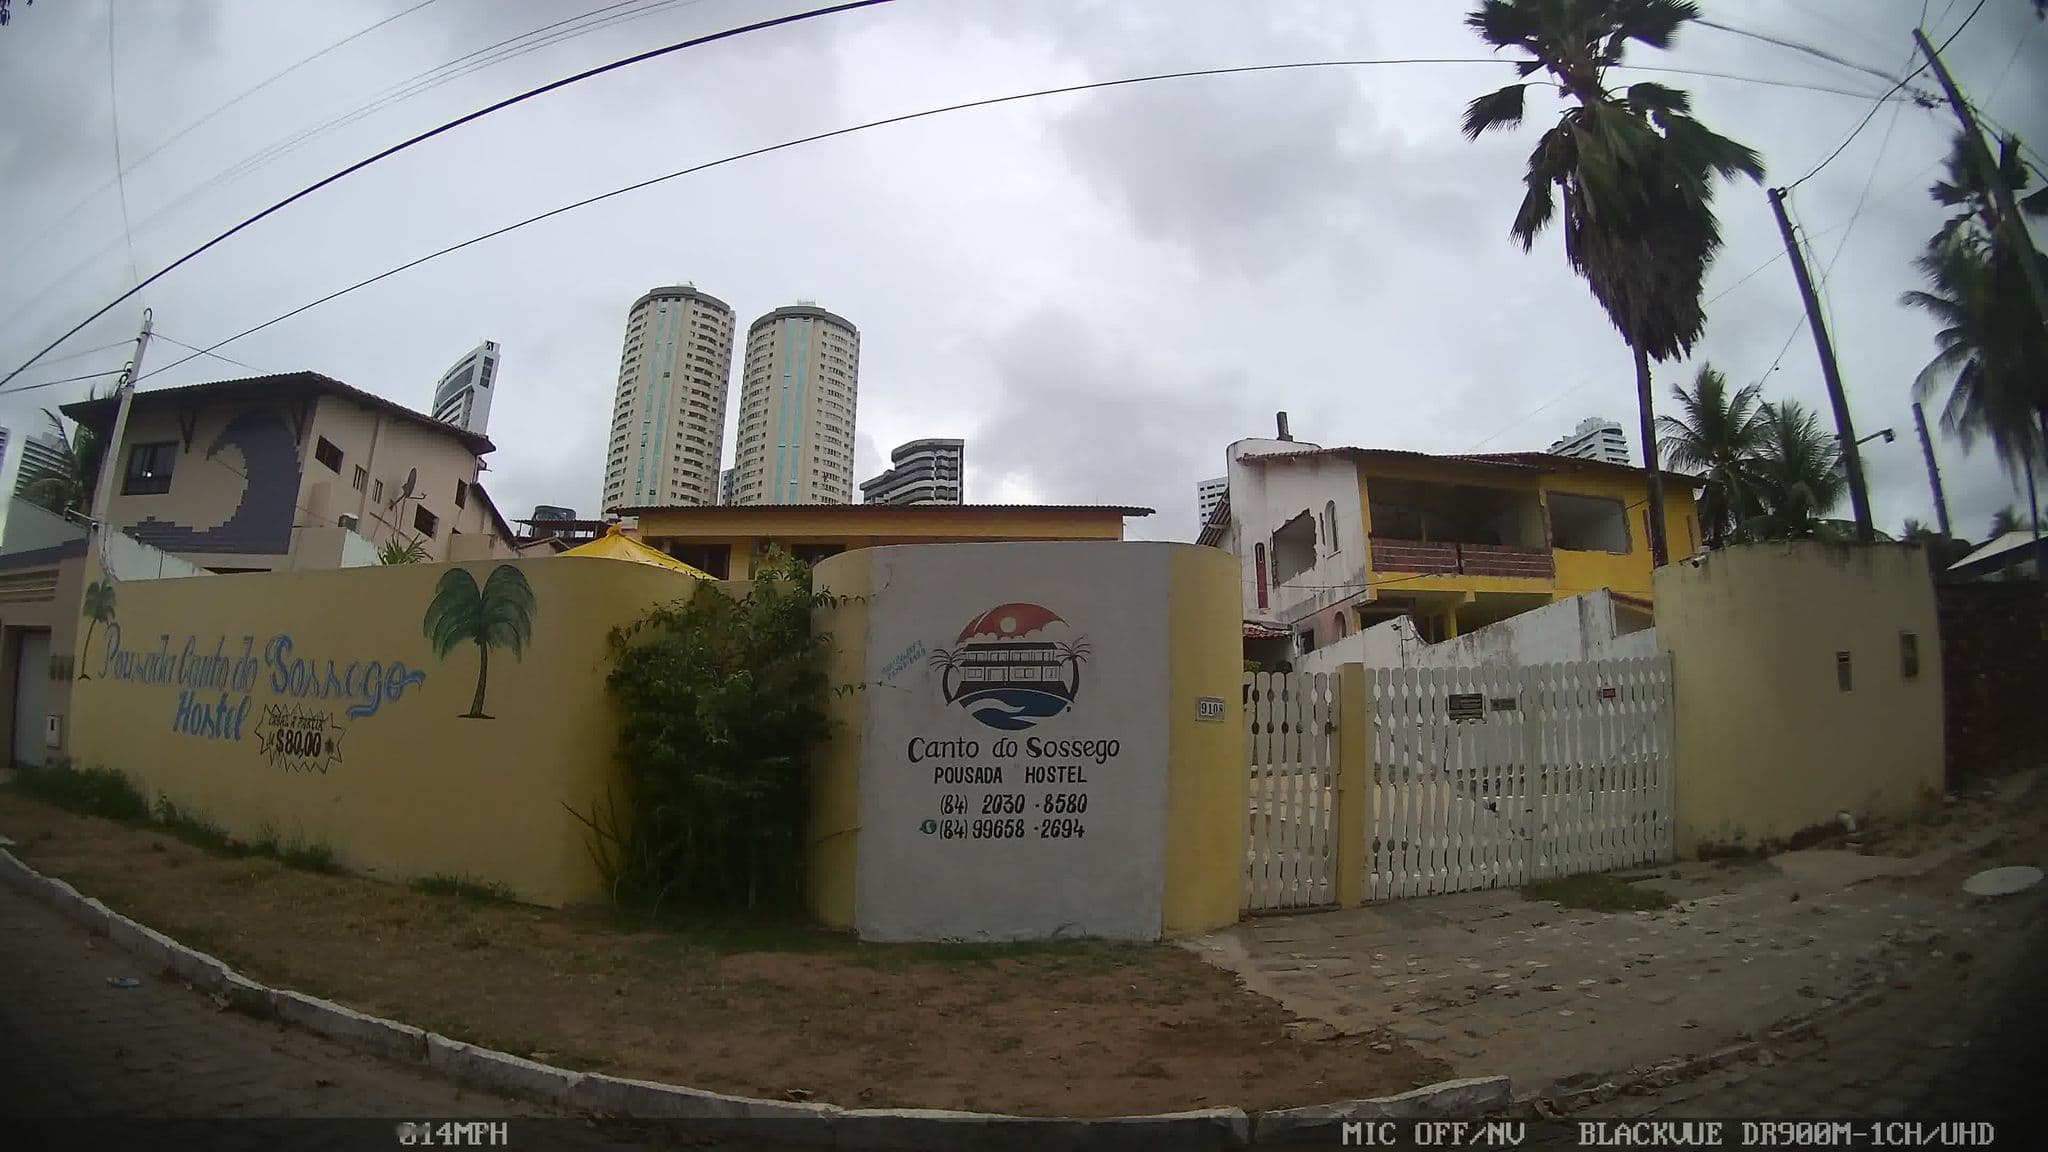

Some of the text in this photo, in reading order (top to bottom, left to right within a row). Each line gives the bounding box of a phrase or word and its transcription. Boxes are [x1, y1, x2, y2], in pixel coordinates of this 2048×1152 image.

[232, 635, 258, 692] do
[172, 689, 252, 742] Hostel
[908, 736, 1120, 763] Canto do Sossego
[934, 766, 1087, 784] POUSADA HOSTEL
[940, 794, 968, 815] (84)
[982, 793, 1025, 814] 2030
[939, 819, 968, 840] (84)
[972, 819, 1025, 839] 99658
